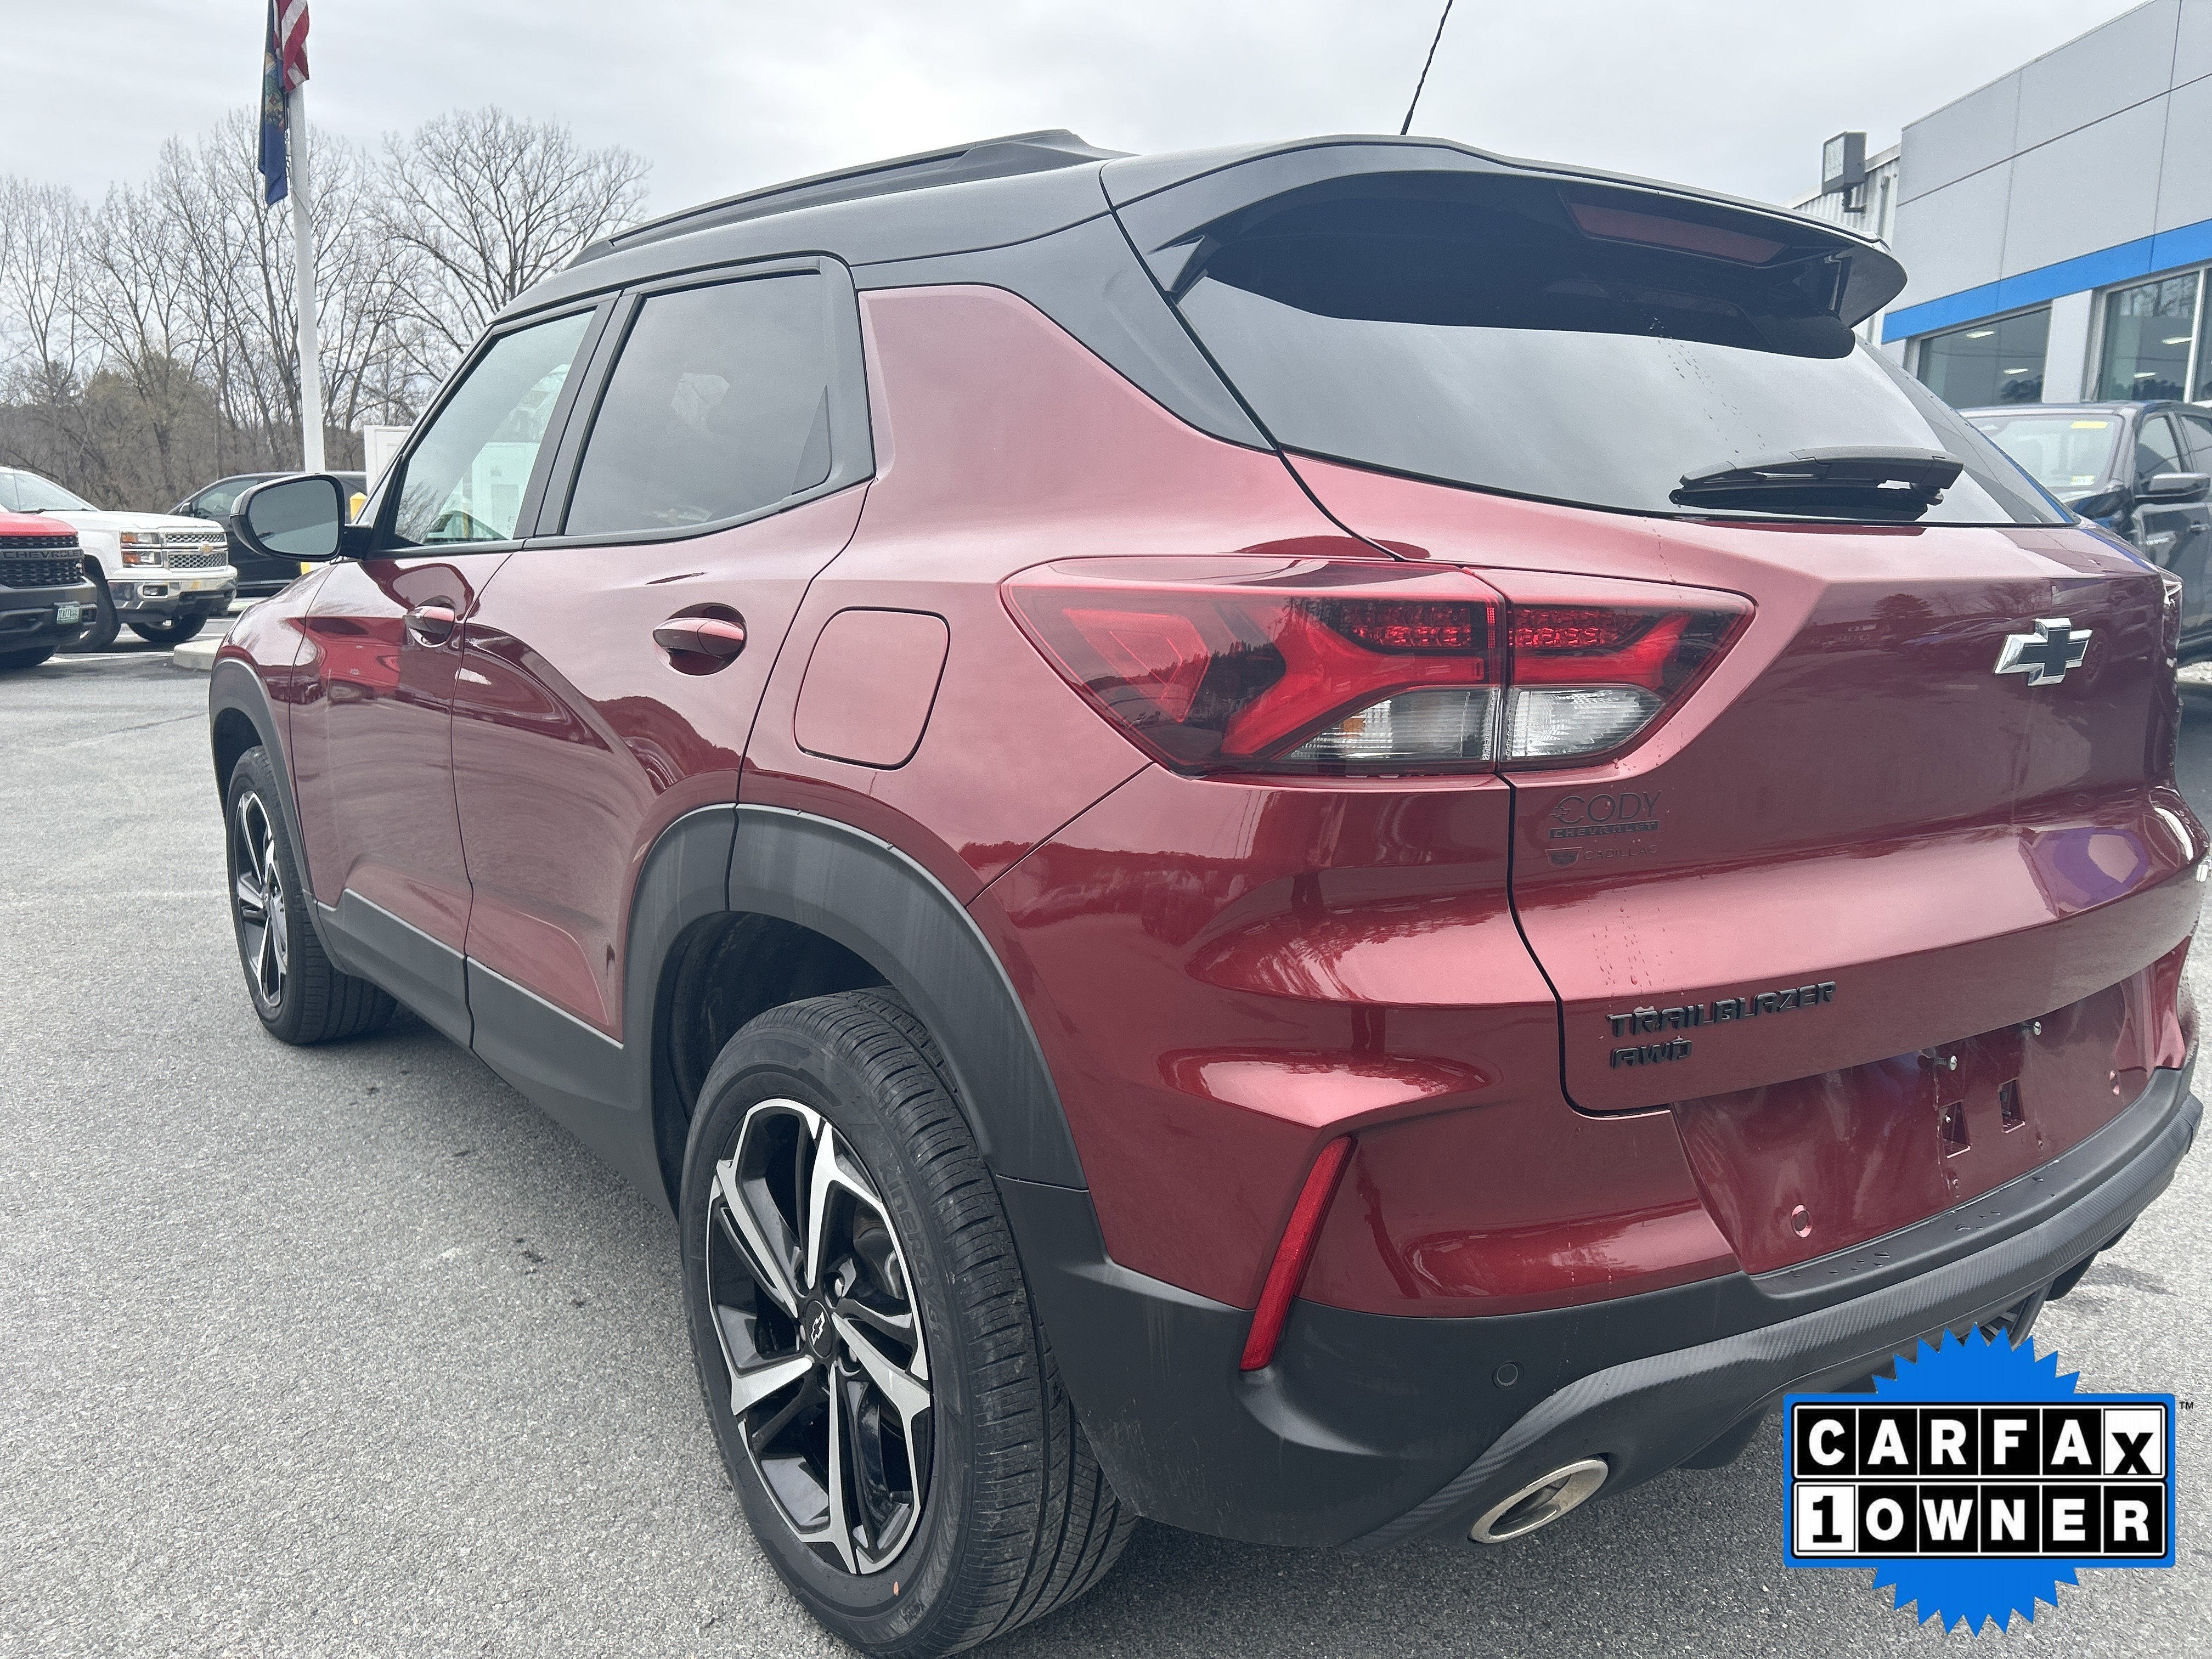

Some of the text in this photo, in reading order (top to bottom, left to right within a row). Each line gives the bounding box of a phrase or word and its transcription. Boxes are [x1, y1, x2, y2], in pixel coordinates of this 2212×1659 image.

[1550, 790, 1663, 825] CODY
[1554, 822, 1656, 838] CHEVROLET
[1584, 845, 1658, 860] CADILLAC
[1606, 981, 1836, 1037] TRAILBLAZER
[1610, 1040, 1692, 1069] AWD
